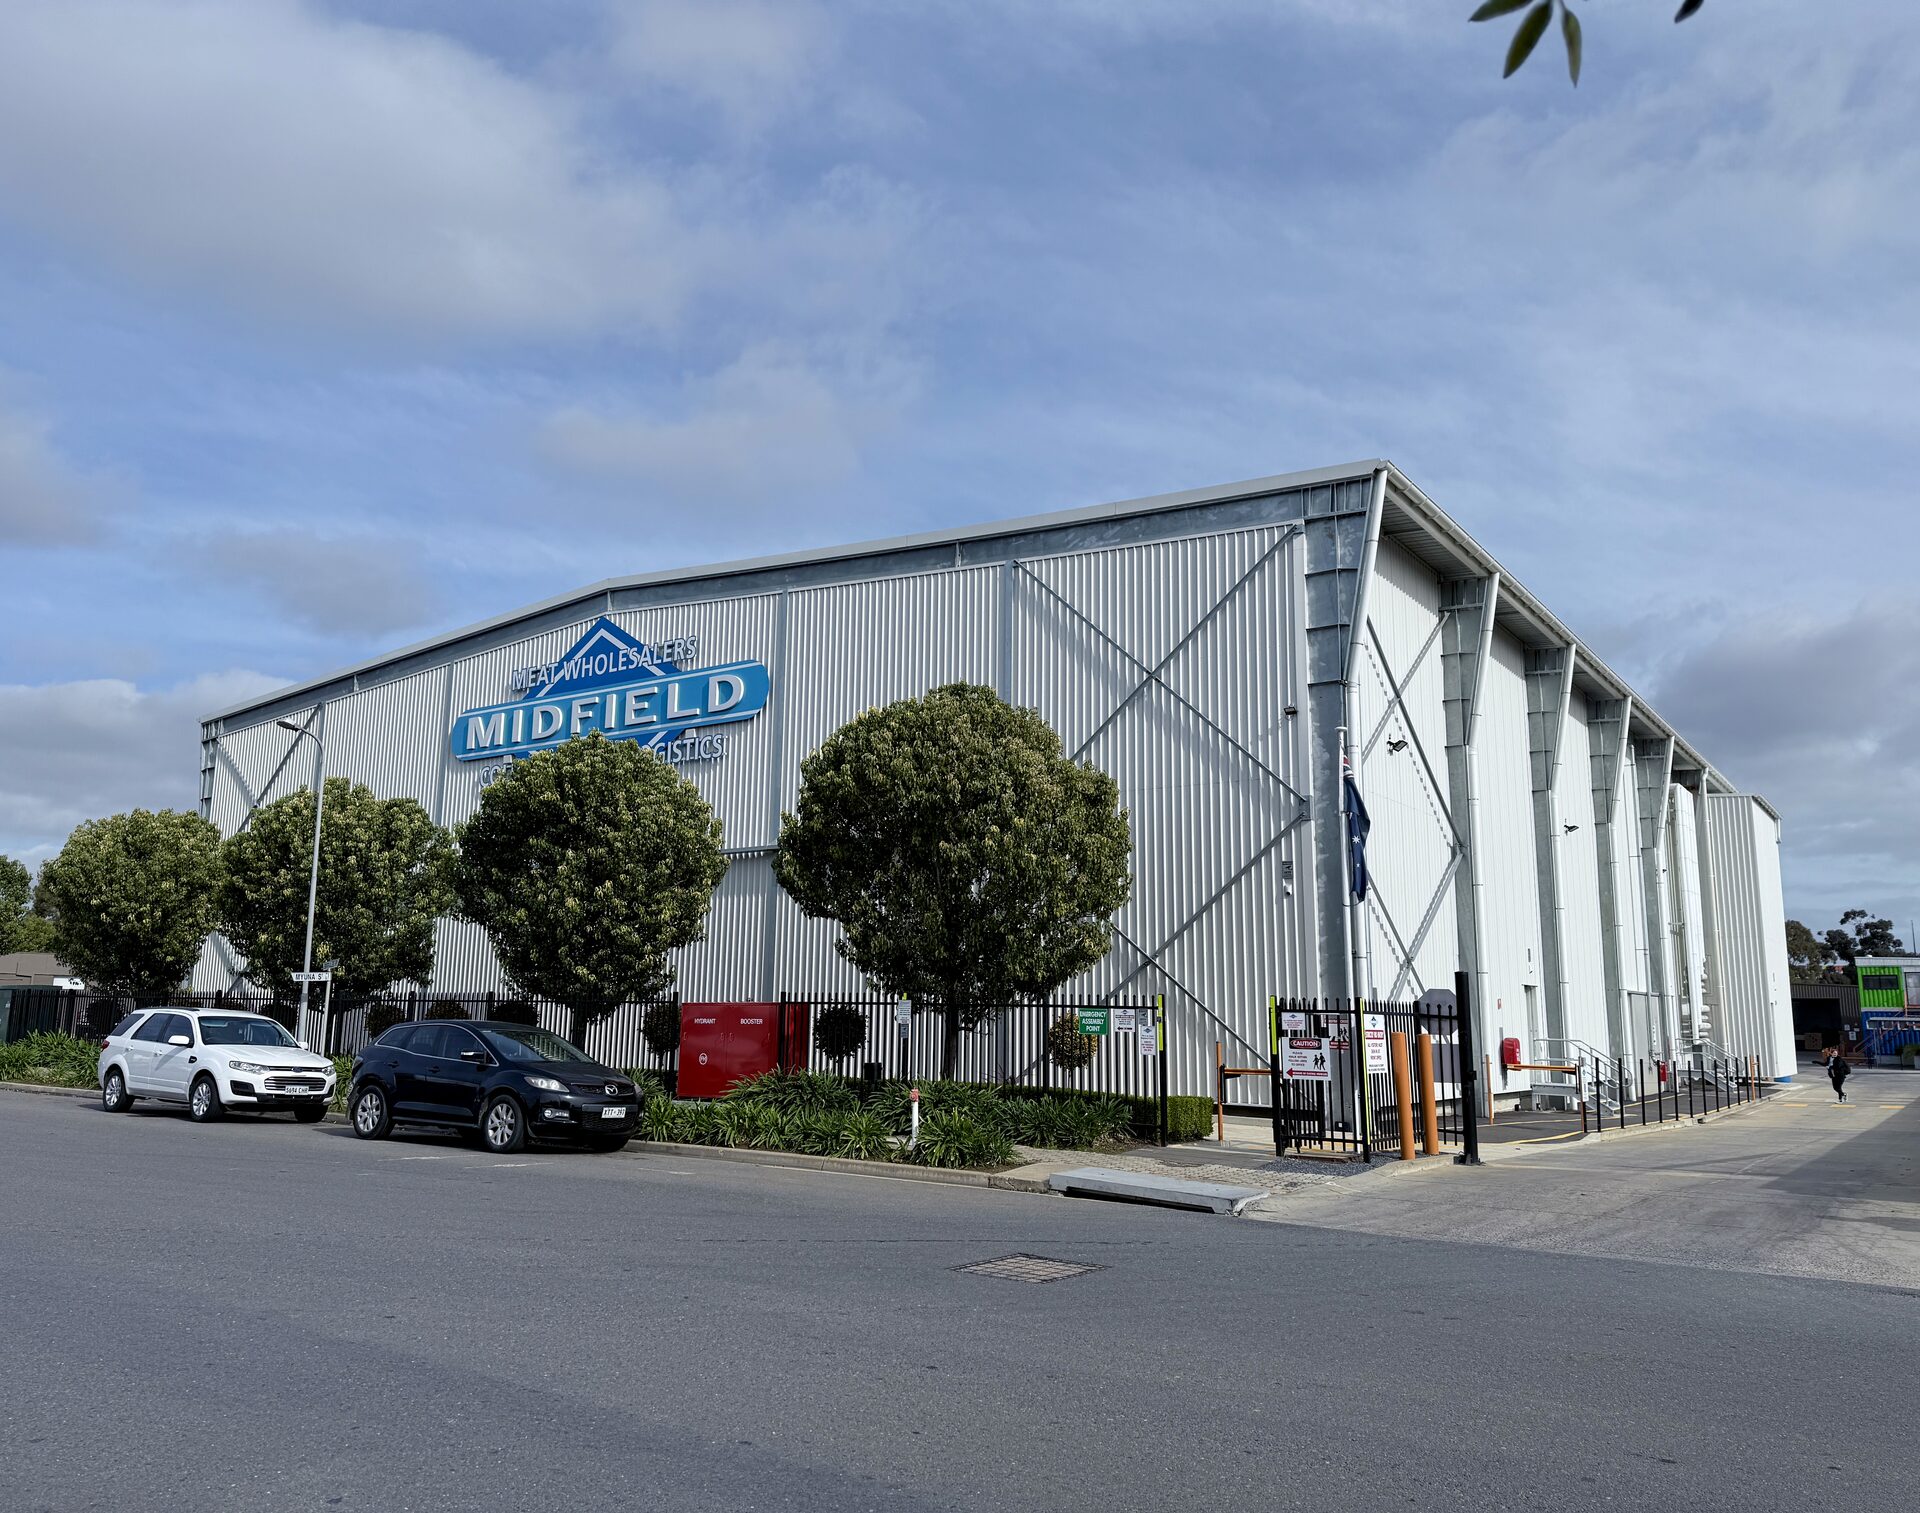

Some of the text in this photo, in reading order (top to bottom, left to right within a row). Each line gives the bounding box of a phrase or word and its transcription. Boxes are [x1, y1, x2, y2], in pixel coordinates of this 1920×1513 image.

[512, 636, 697, 692] MEAT WHOLESALERS
[465, 674, 745, 750] MIDFIELD
[640, 734, 724, 765] GISTICS
[1292, 1040, 1318, 1048] CAUTION
